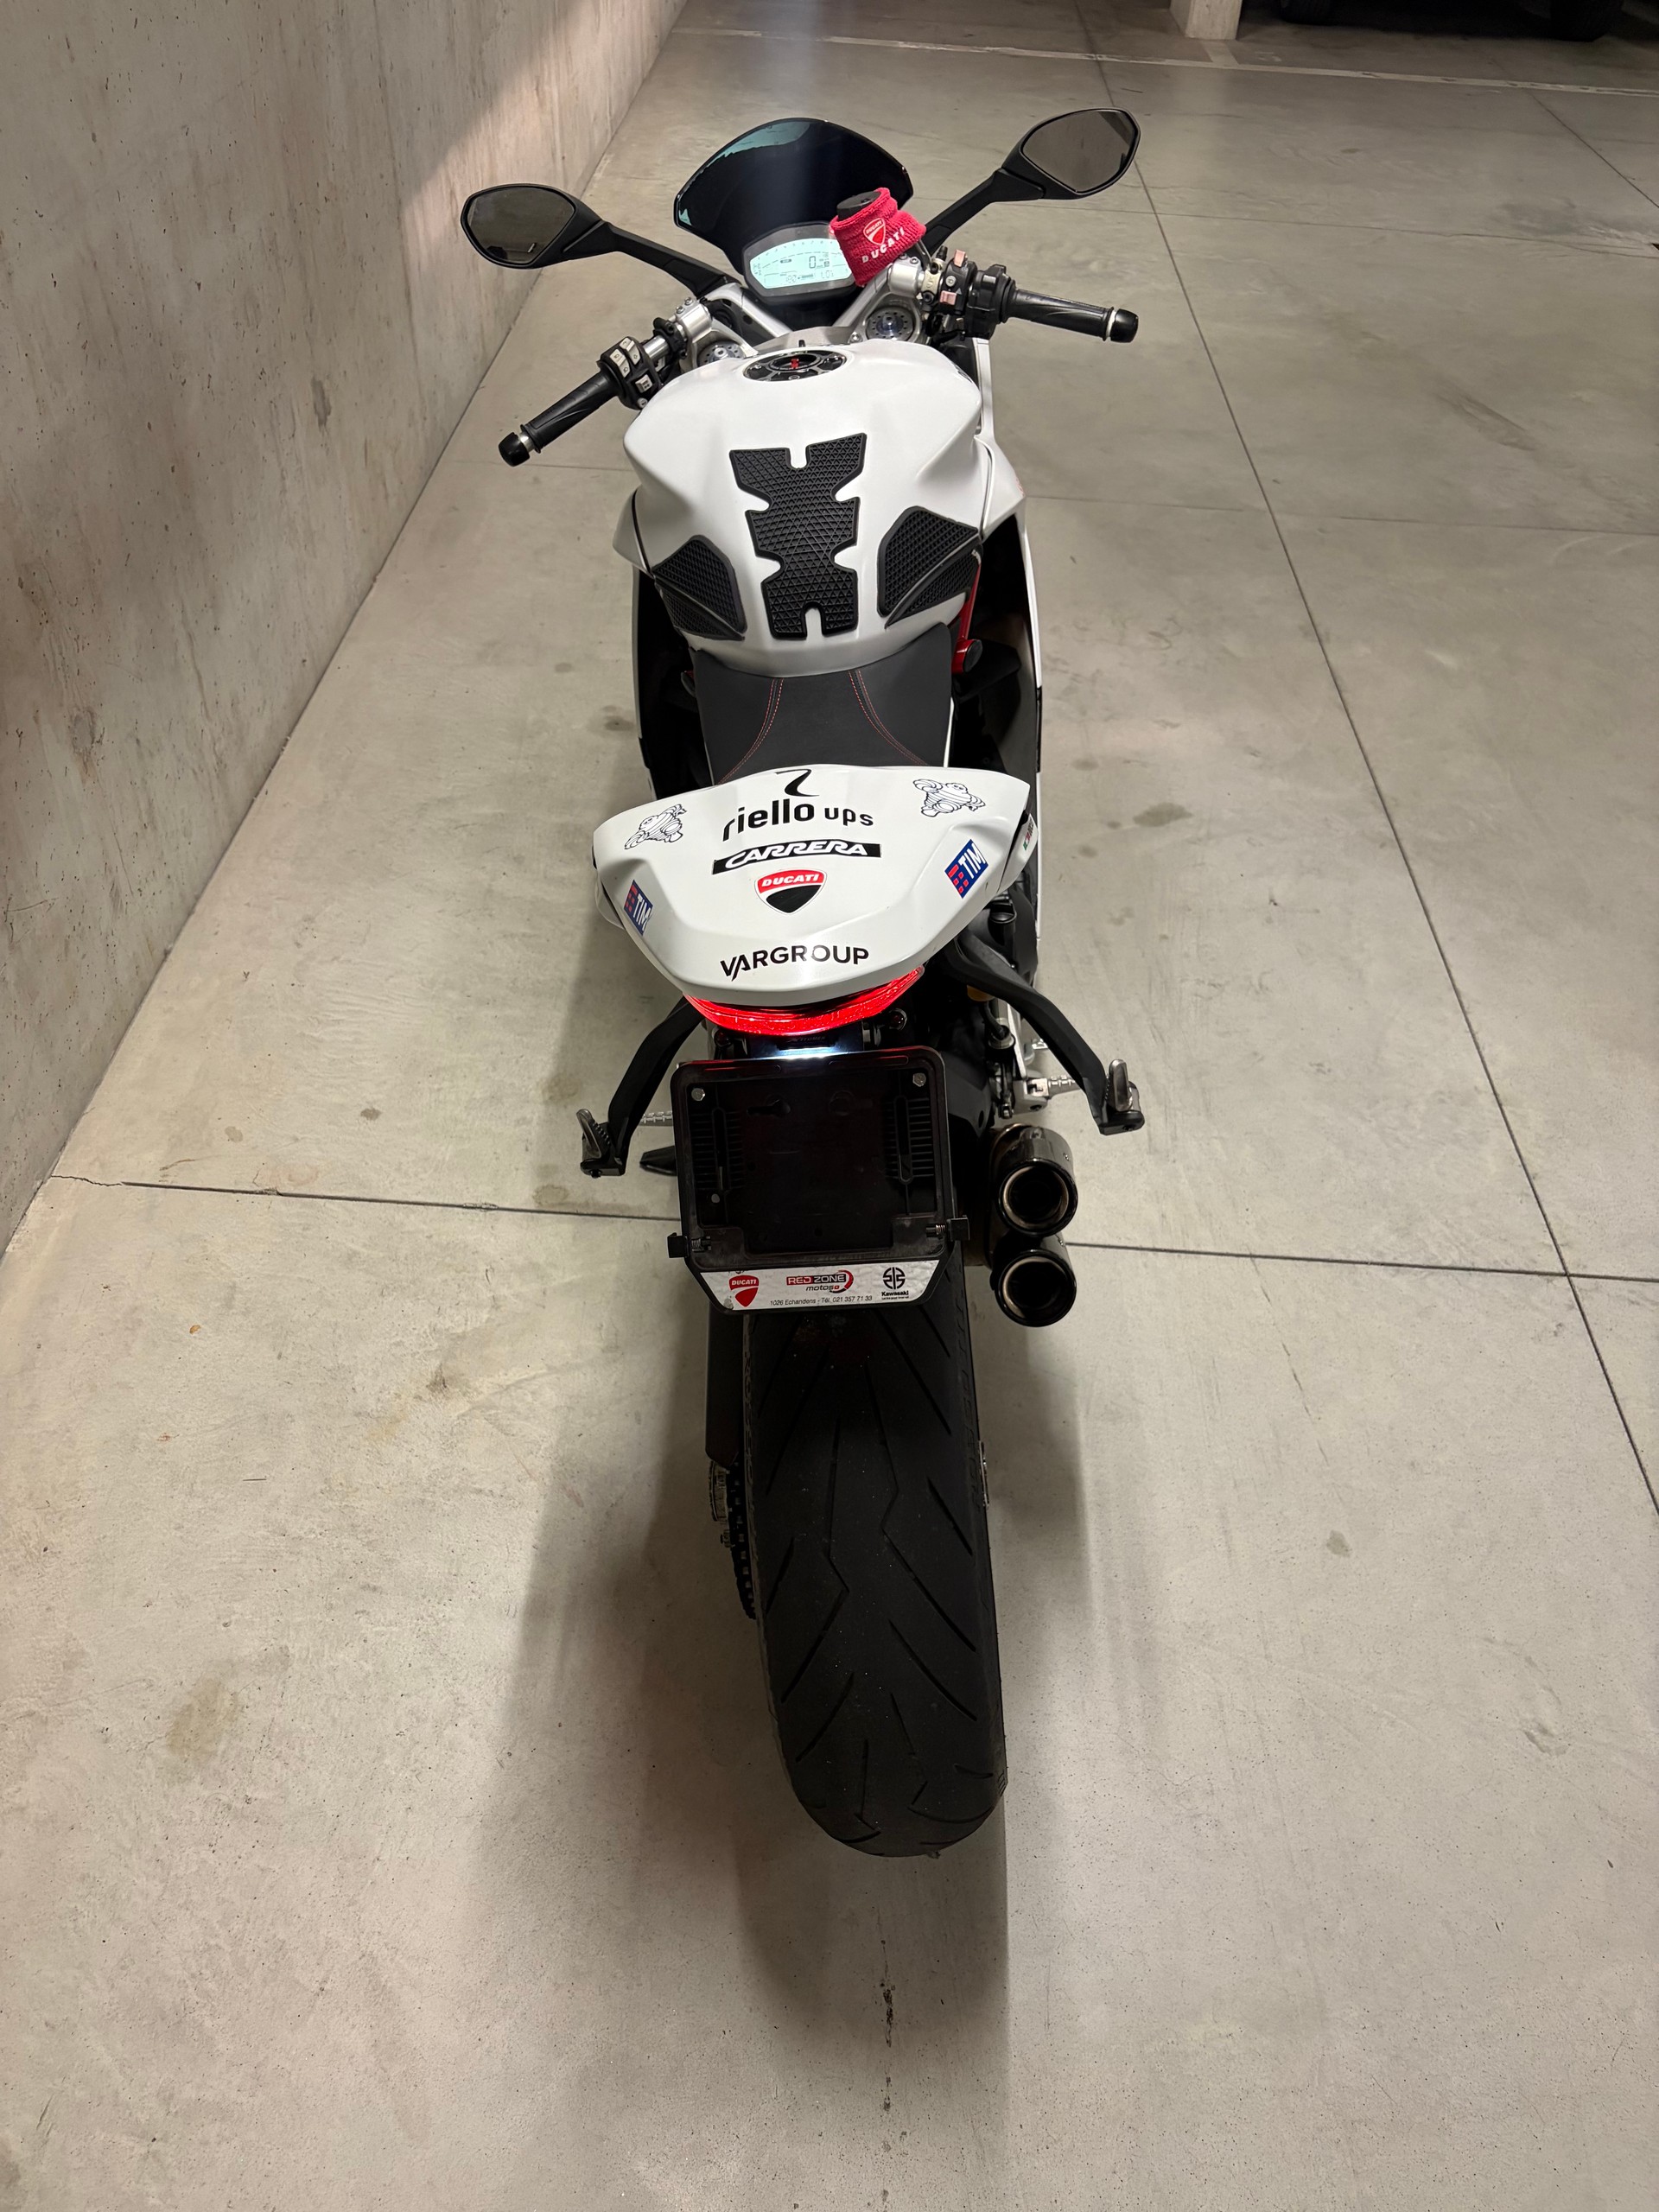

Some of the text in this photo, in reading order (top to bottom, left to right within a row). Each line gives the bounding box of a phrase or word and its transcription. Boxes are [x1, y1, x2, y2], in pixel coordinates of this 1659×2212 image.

[861, 226, 905, 264] DUCATI
[722, 798, 874, 842] riello ups
[725, 840, 868, 869] CARRERA
[957, 842, 987, 880] TIM
[761, 874, 820, 887] DUCATI
[632, 893, 652, 931] TIM
[720, 944, 869, 982] VARGROUP
[813, 1274, 845, 1283] ZONE
